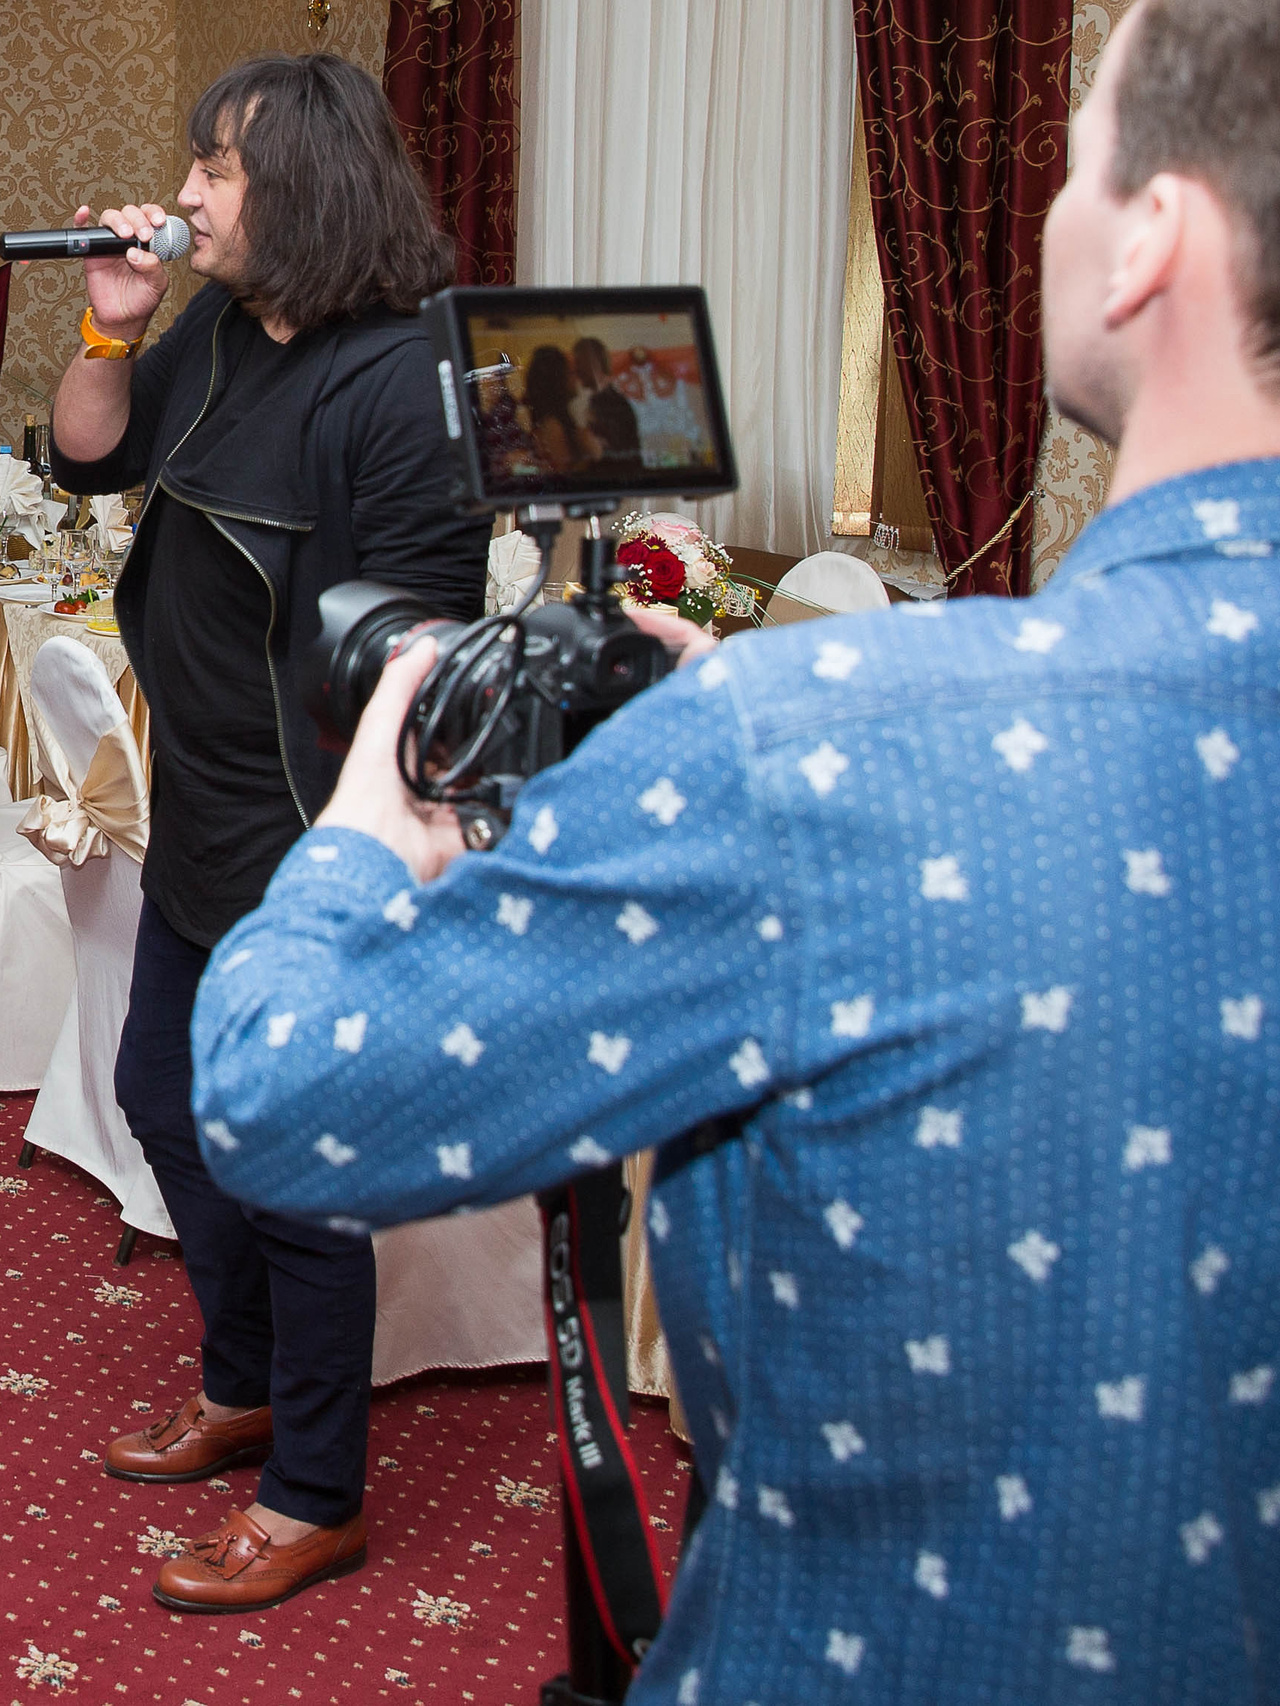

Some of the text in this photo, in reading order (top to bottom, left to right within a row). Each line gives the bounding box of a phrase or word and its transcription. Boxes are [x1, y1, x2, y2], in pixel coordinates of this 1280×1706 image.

[557, 1316, 583, 1368] 5D
[566, 1375, 592, 1443] Mark
[578, 1441, 603, 1469] III
